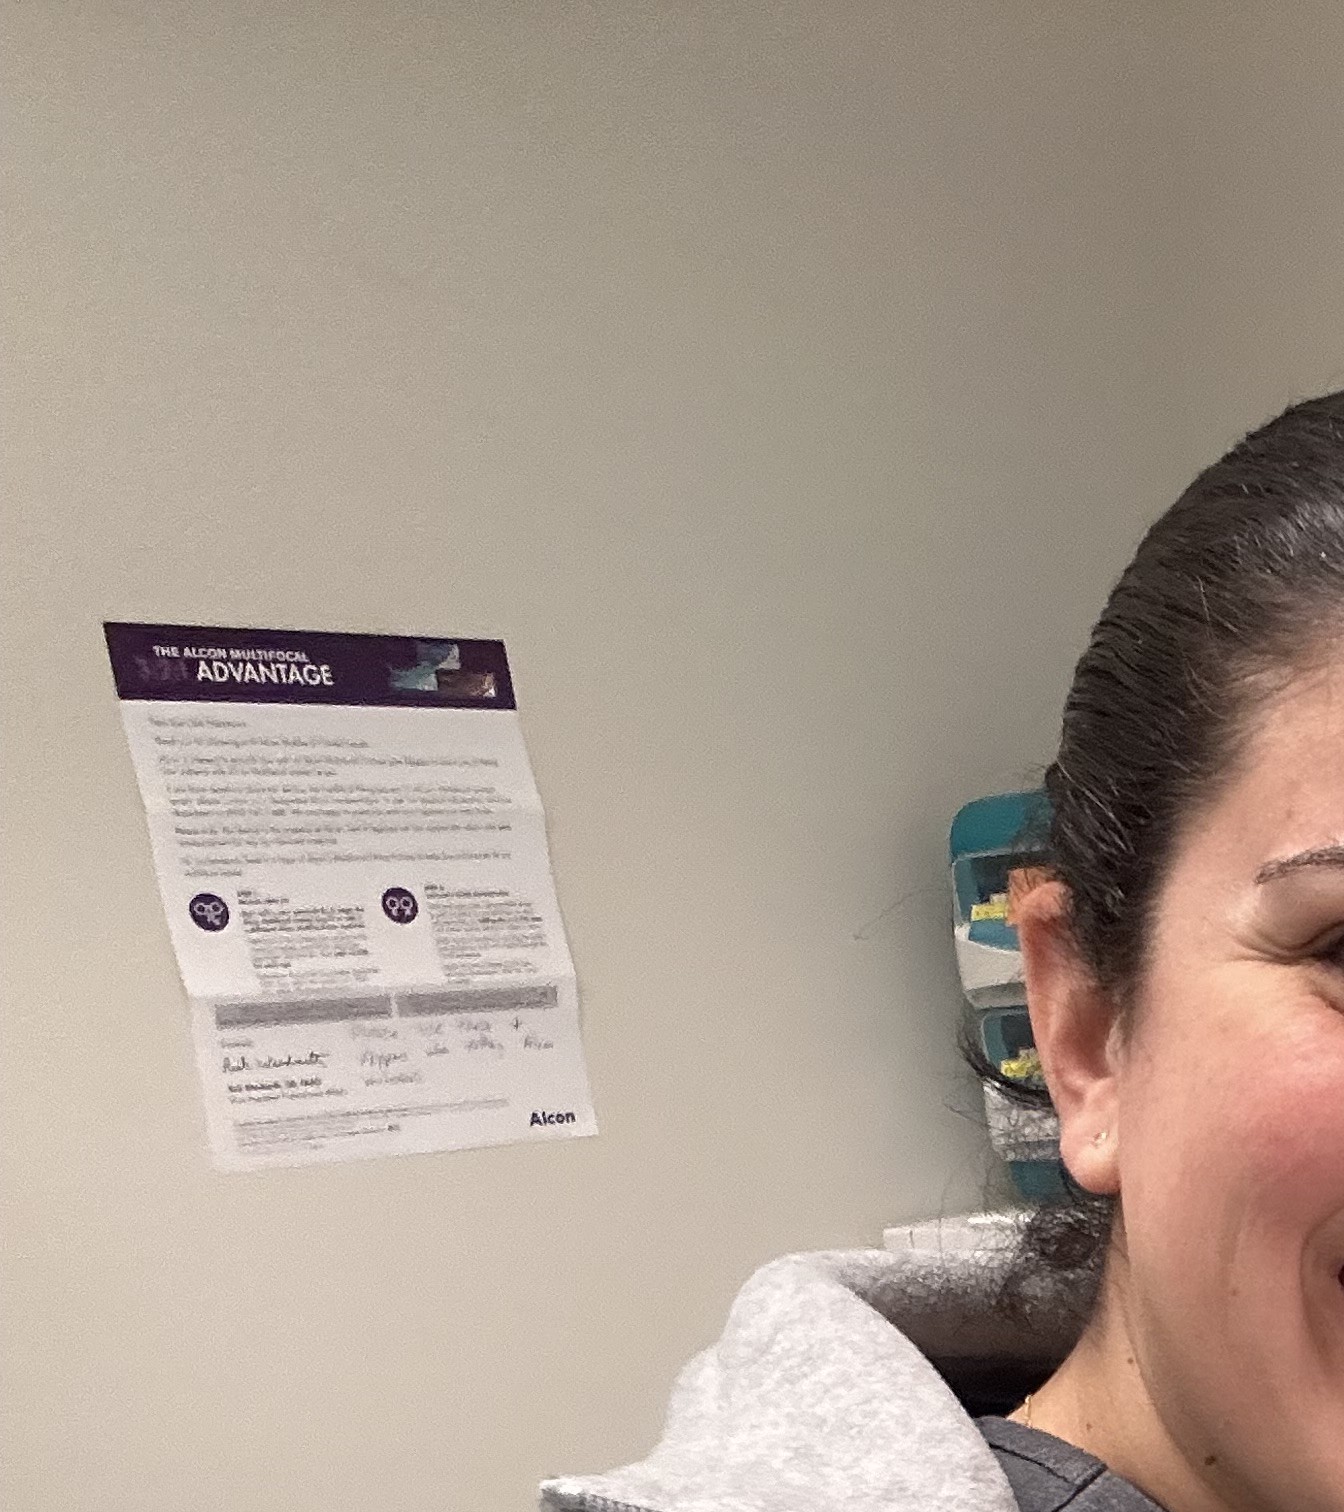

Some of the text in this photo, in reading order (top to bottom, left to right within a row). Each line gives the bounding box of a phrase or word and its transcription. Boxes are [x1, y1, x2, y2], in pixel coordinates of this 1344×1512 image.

[153, 645, 310, 663] THE ALCON MULTIFOCAL
[197, 660, 335, 687] ADVANTAGE
[529, 1109, 577, 1129] Alcon
